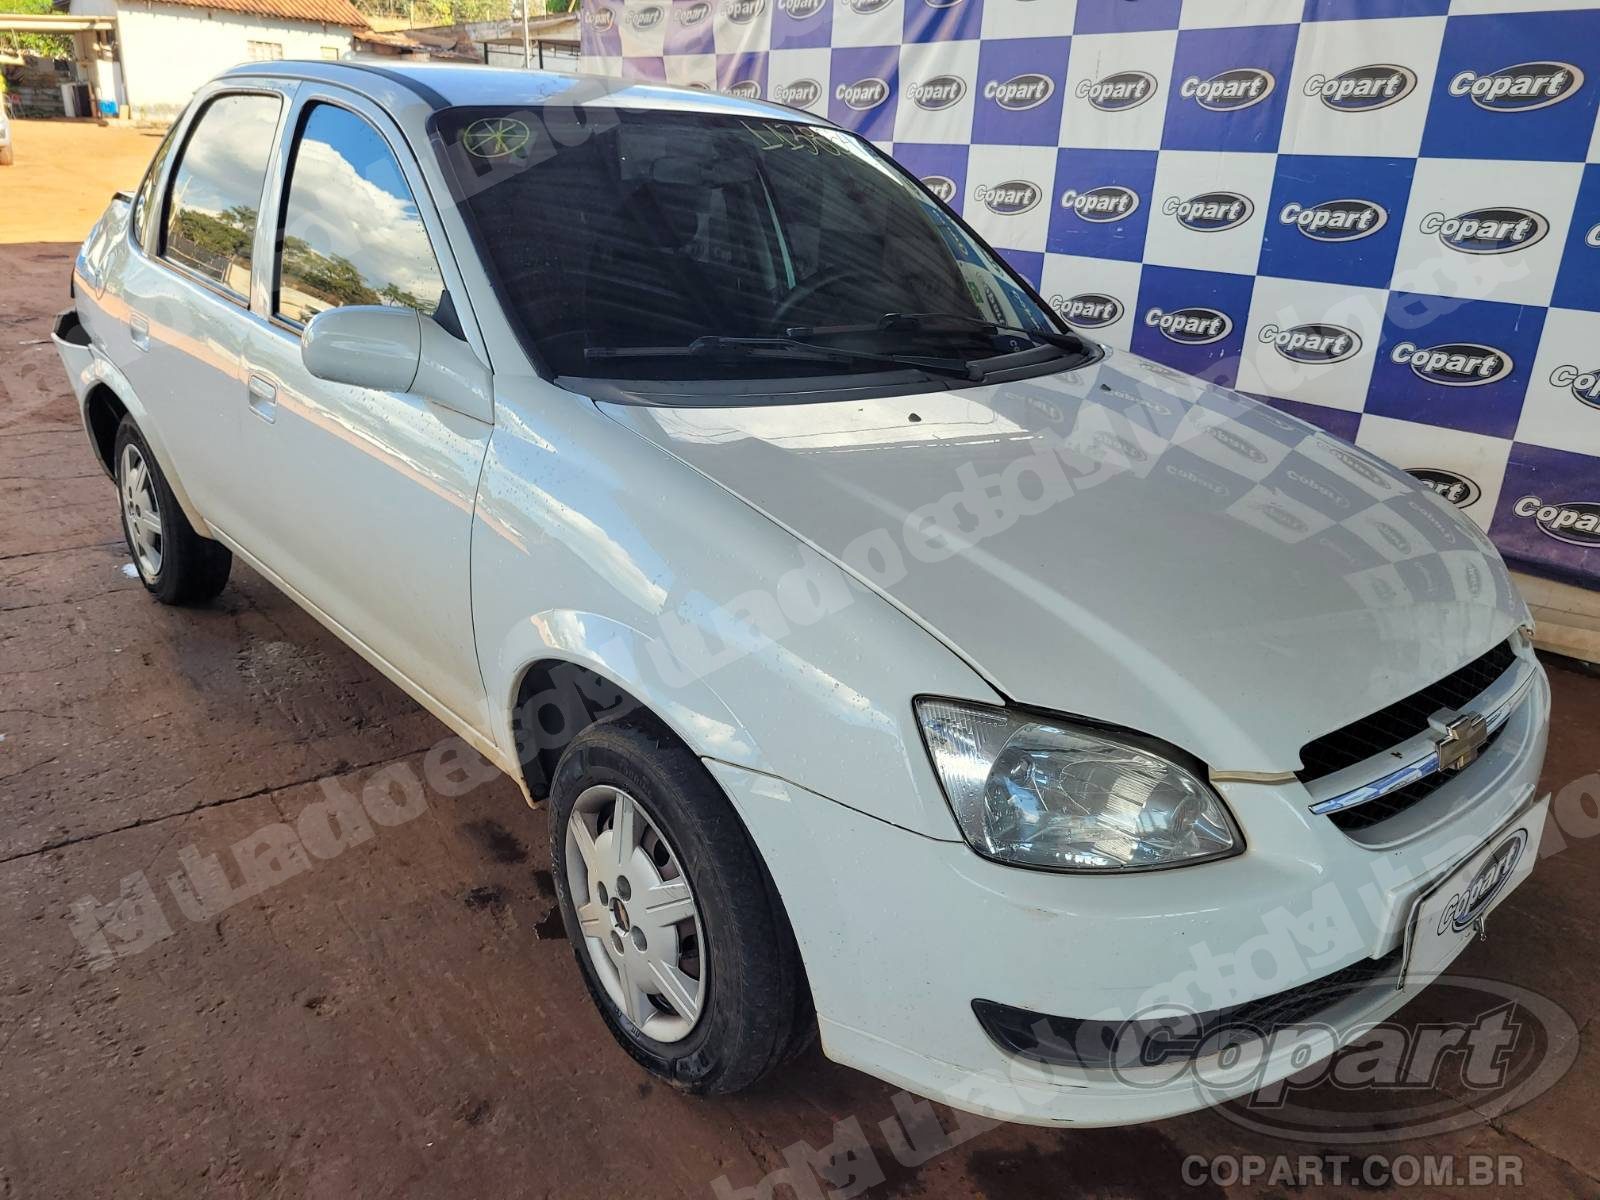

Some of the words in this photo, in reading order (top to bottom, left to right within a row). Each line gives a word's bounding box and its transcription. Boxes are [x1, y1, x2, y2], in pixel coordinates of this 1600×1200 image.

[774, 84, 814, 104] Copart
[835, 83, 884, 101] Copart
[904, 83, 956, 102] Copart
[984, 80, 1045, 103] Copart
[1075, 78, 1146, 103] Copart
[1181, 75, 1264, 102] Copart
[1303, 73, 1401, 102] Copart
[1449, 67, 1566, 103] Copart
[974, 184, 1034, 207] Copart
[1061, 189, 1130, 214] Copart
[1162, 196, 1241, 222] Copart
[1280, 203, 1375, 233] Copart
[1419, 212, 1531, 242] Copart
[1050, 294, 1114, 321] Copart
[1145, 308, 1222, 336] Copart
[1259, 324, 1348, 356] Copart
[1391, 341, 1499, 378] Copart
[1513, 496, 1600, 534] Copa
[1437, 843, 1515, 937] Copart
